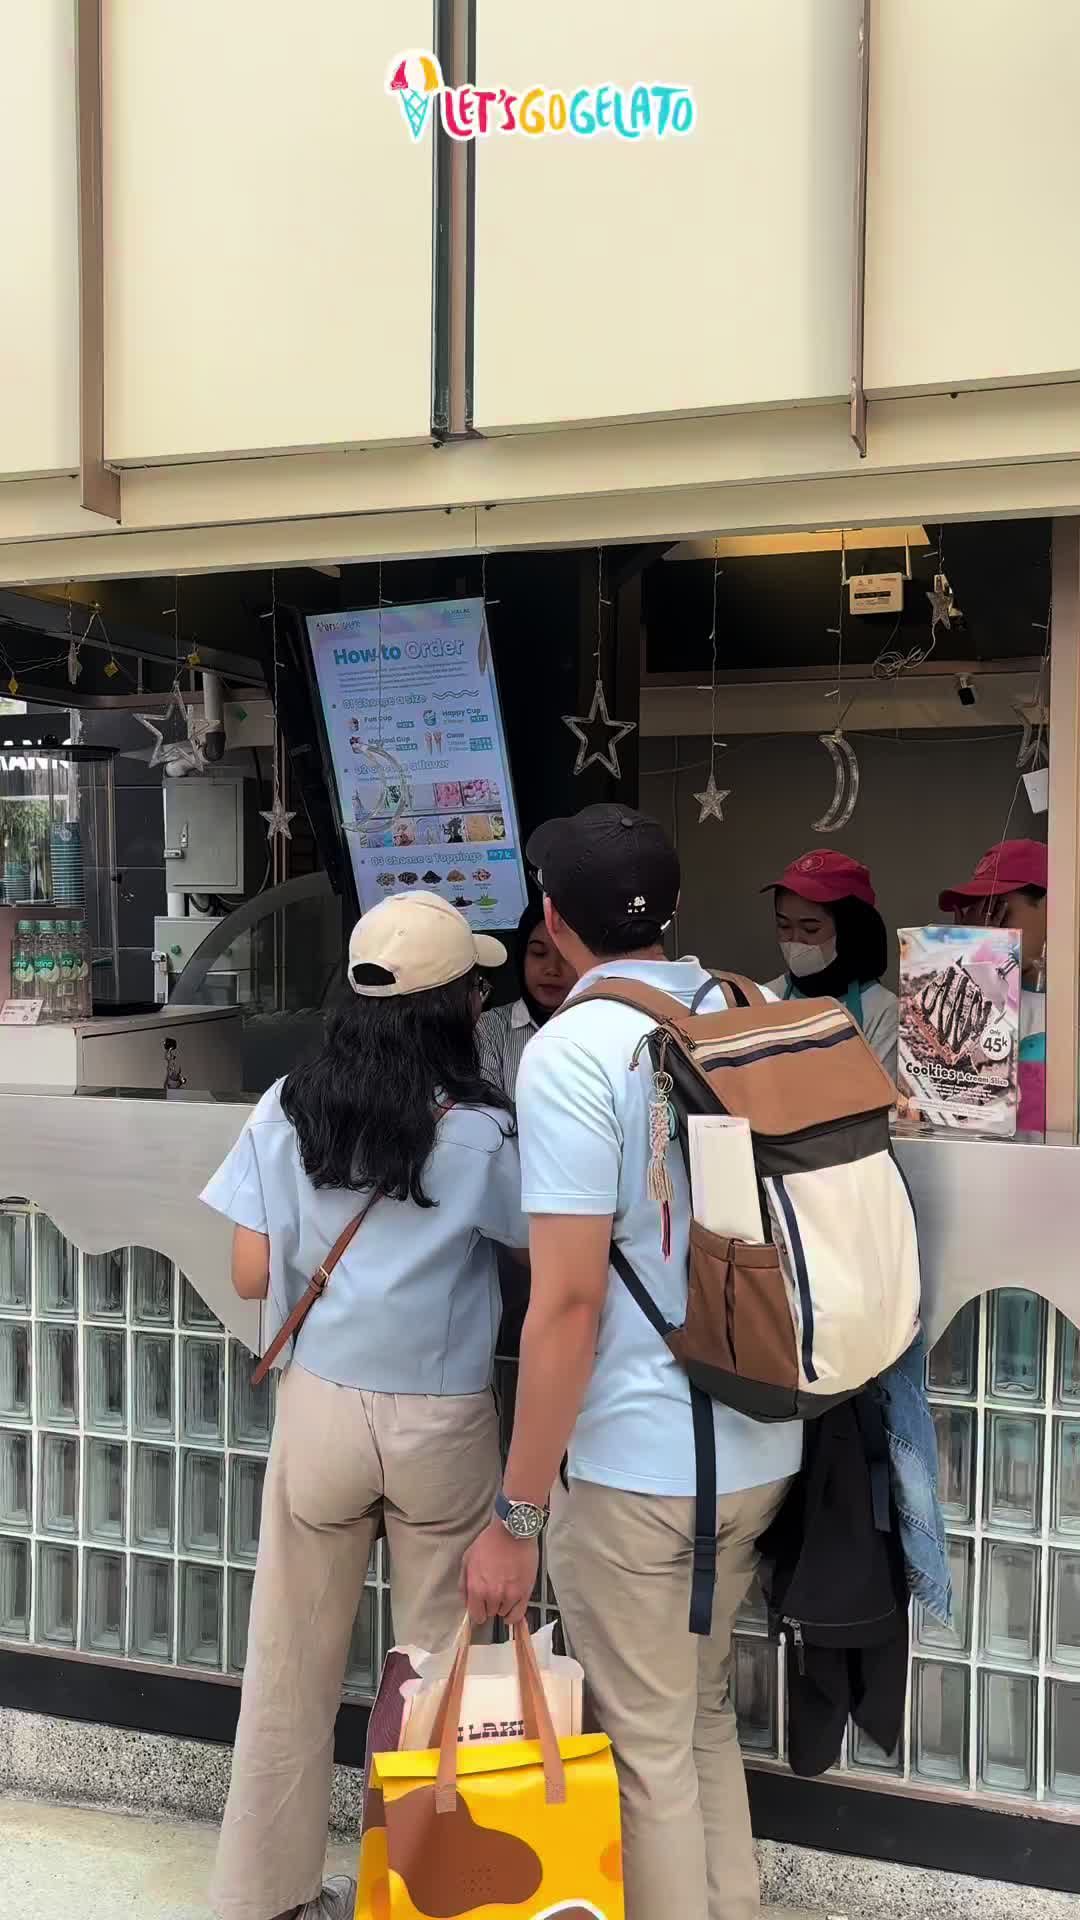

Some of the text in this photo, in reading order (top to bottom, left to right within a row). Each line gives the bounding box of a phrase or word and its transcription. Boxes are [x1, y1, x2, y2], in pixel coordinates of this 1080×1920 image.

[333, 639, 465, 665] How to Order
[905, 1061, 956, 1081] Cookies
[965, 1073, 989, 1085] Cream
